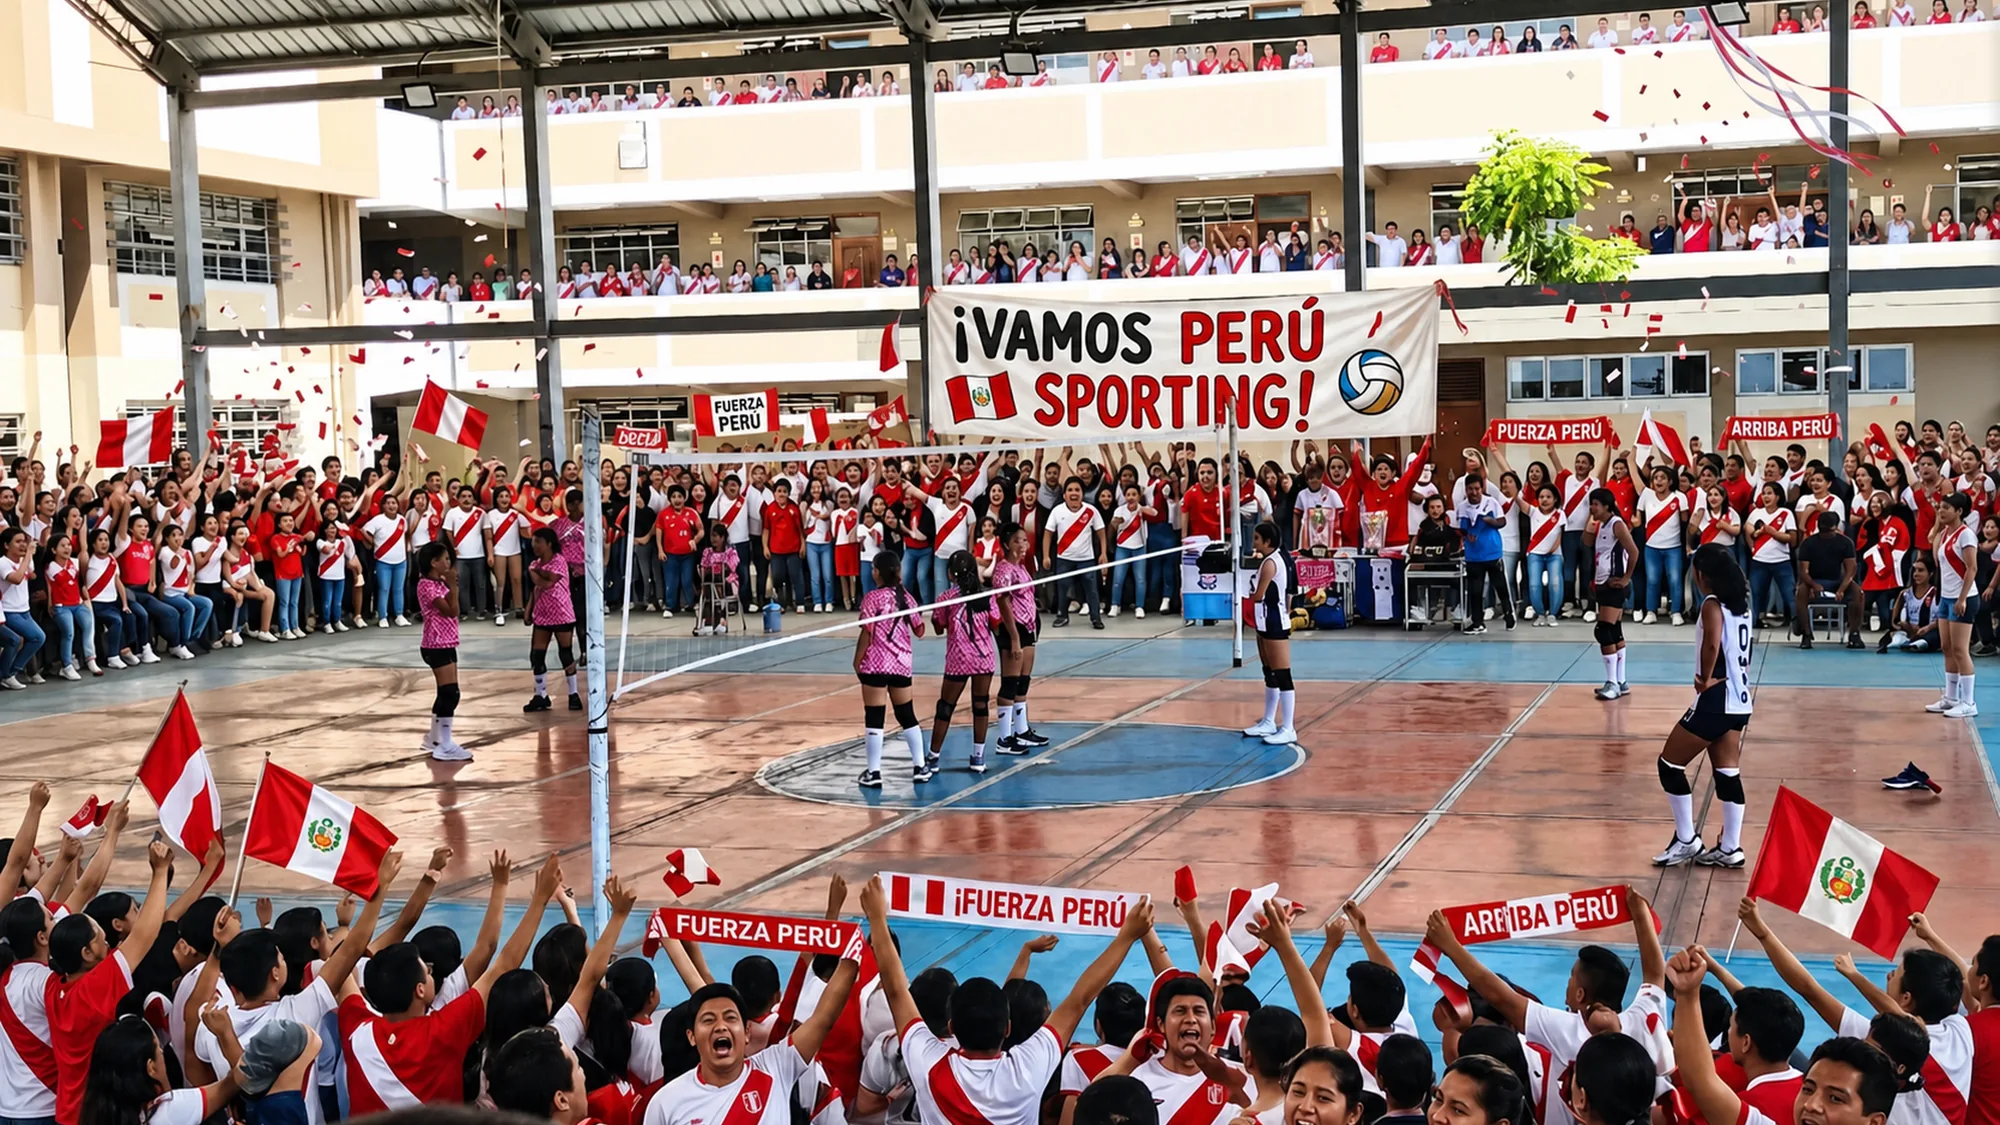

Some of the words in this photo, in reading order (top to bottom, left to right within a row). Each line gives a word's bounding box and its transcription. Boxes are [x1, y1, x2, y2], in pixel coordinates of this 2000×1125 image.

[953, 305, 1152, 364] ¡VAMOS
[1180, 296, 1324, 364] PERÚ
[715, 397, 764, 413] FUERZA
[1034, 370, 1315, 432] SPORTING!
[719, 411, 761, 432] PERÚ
[1498, 423, 1557, 440] PUERZA
[1562, 419, 1602, 440] PERÚ
[1732, 420, 1788, 437] ARRIBA
[1792, 415, 1832, 436] PERÚ
[955, 888, 1054, 922] ¡FUERZA
[1062, 895, 1126, 928] PERÚ
[1555, 889, 1618, 926] PERÚ
[676, 914, 770, 942] FUERZA
[777, 924, 841, 948] PERÚ
